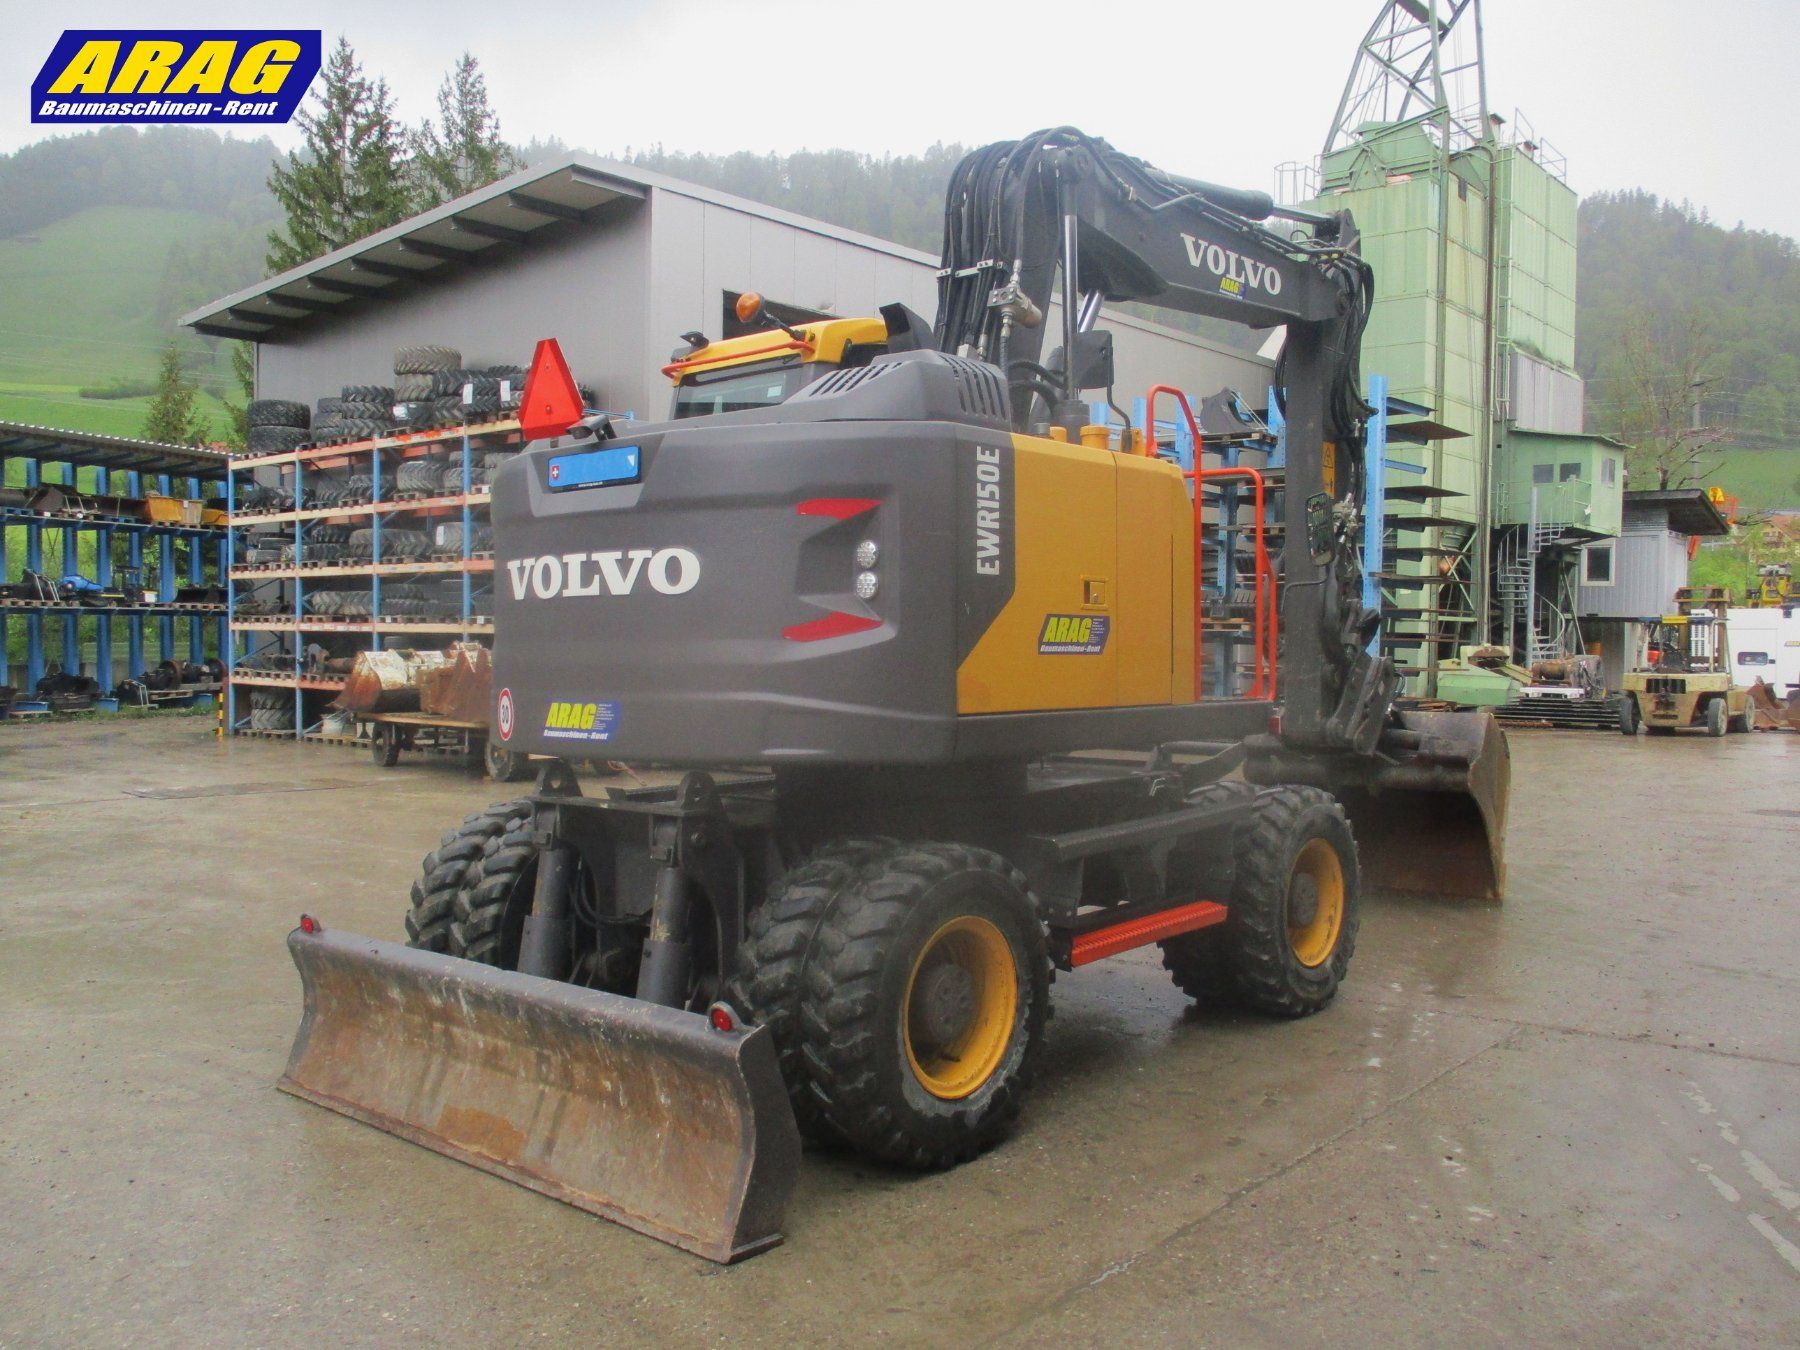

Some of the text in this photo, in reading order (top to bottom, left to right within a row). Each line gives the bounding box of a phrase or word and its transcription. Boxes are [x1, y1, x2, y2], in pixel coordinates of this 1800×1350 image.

[1180, 232, 1282, 296] VOLVO
[976, 445, 1000, 576] EWR150E
[507, 548, 701, 601] VOLVO
[1042, 616, 1093, 643] ARAG
[545, 702, 597, 730] ARAG
